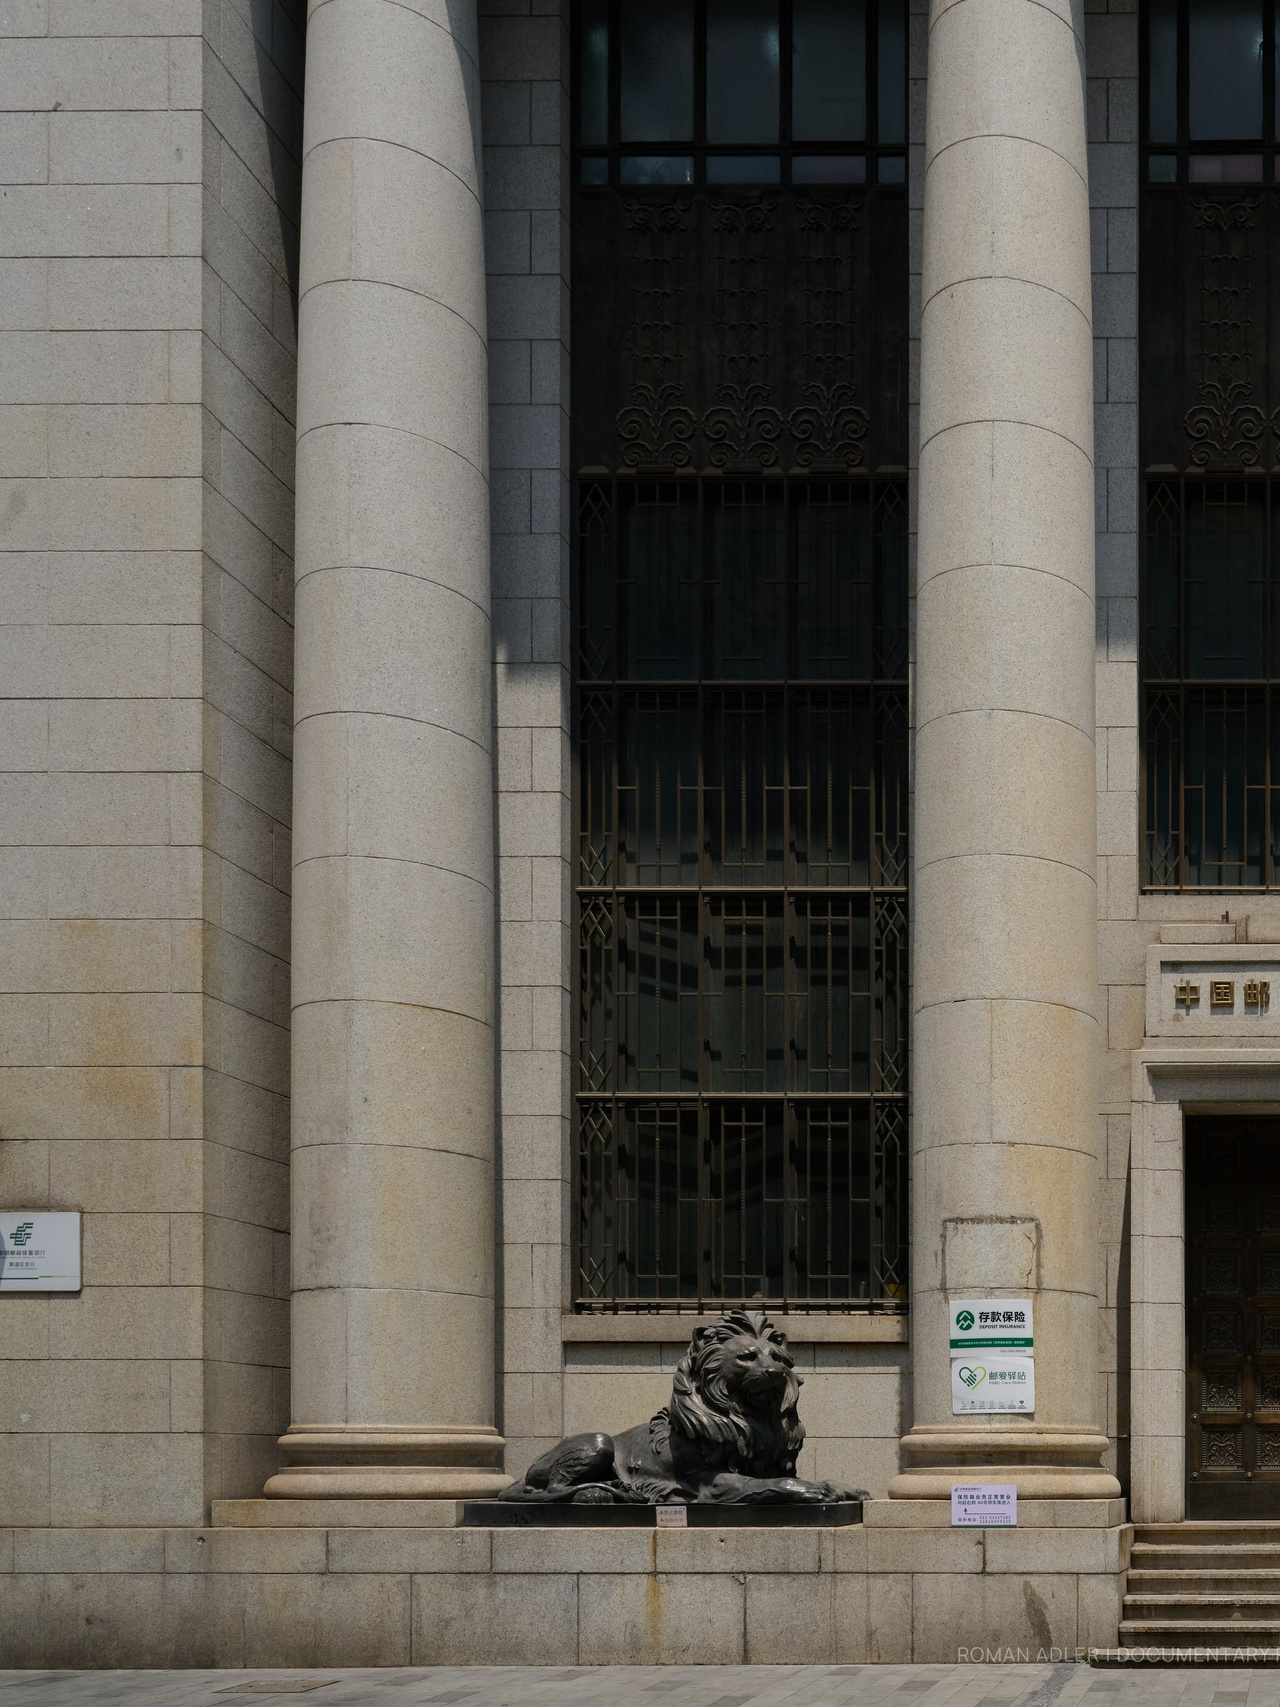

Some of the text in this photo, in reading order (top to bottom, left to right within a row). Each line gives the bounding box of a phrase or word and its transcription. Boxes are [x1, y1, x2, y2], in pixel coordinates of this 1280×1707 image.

[978, 1311, 1026, 1323] 存款保险
[988, 1371, 1026, 1381] 邮爱驿站
